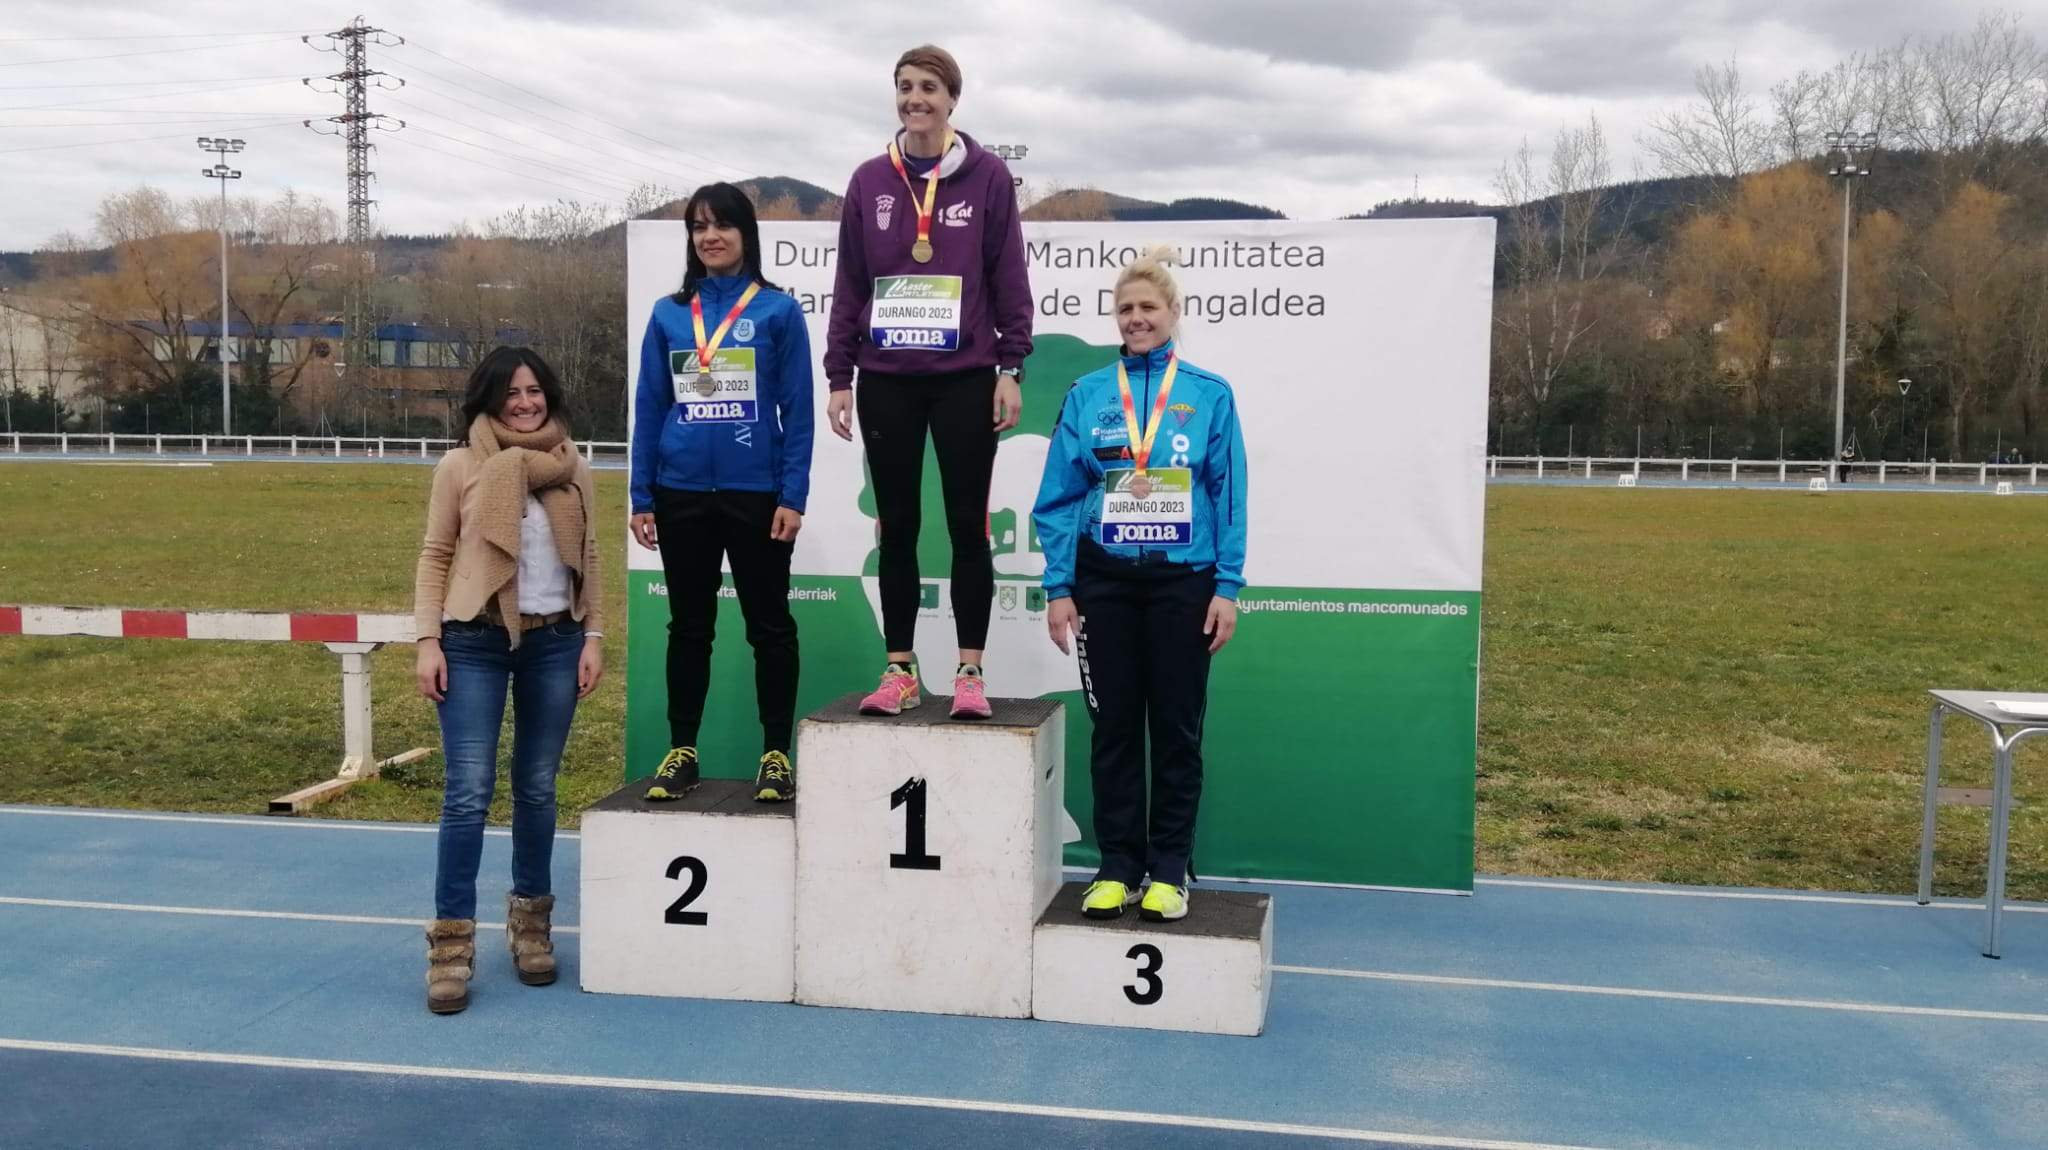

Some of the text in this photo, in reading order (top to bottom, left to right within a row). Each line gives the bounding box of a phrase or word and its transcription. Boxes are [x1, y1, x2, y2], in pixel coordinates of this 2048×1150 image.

[1026, 241, 1325, 268] Mankounitatea
[878, 306, 953, 319] DURANGO 2023
[1040, 287, 1325, 323] de Dngaldea
[679, 380, 749, 393] DURO 2023
[1109, 501, 1184, 513] DURANGO 2023
[1235, 597, 1467, 616] Ayuntamientos mancomunados
[889, 776, 941, 870] 1
[664, 855, 708, 926] 2
[1123, 943, 1164, 1005] 3
